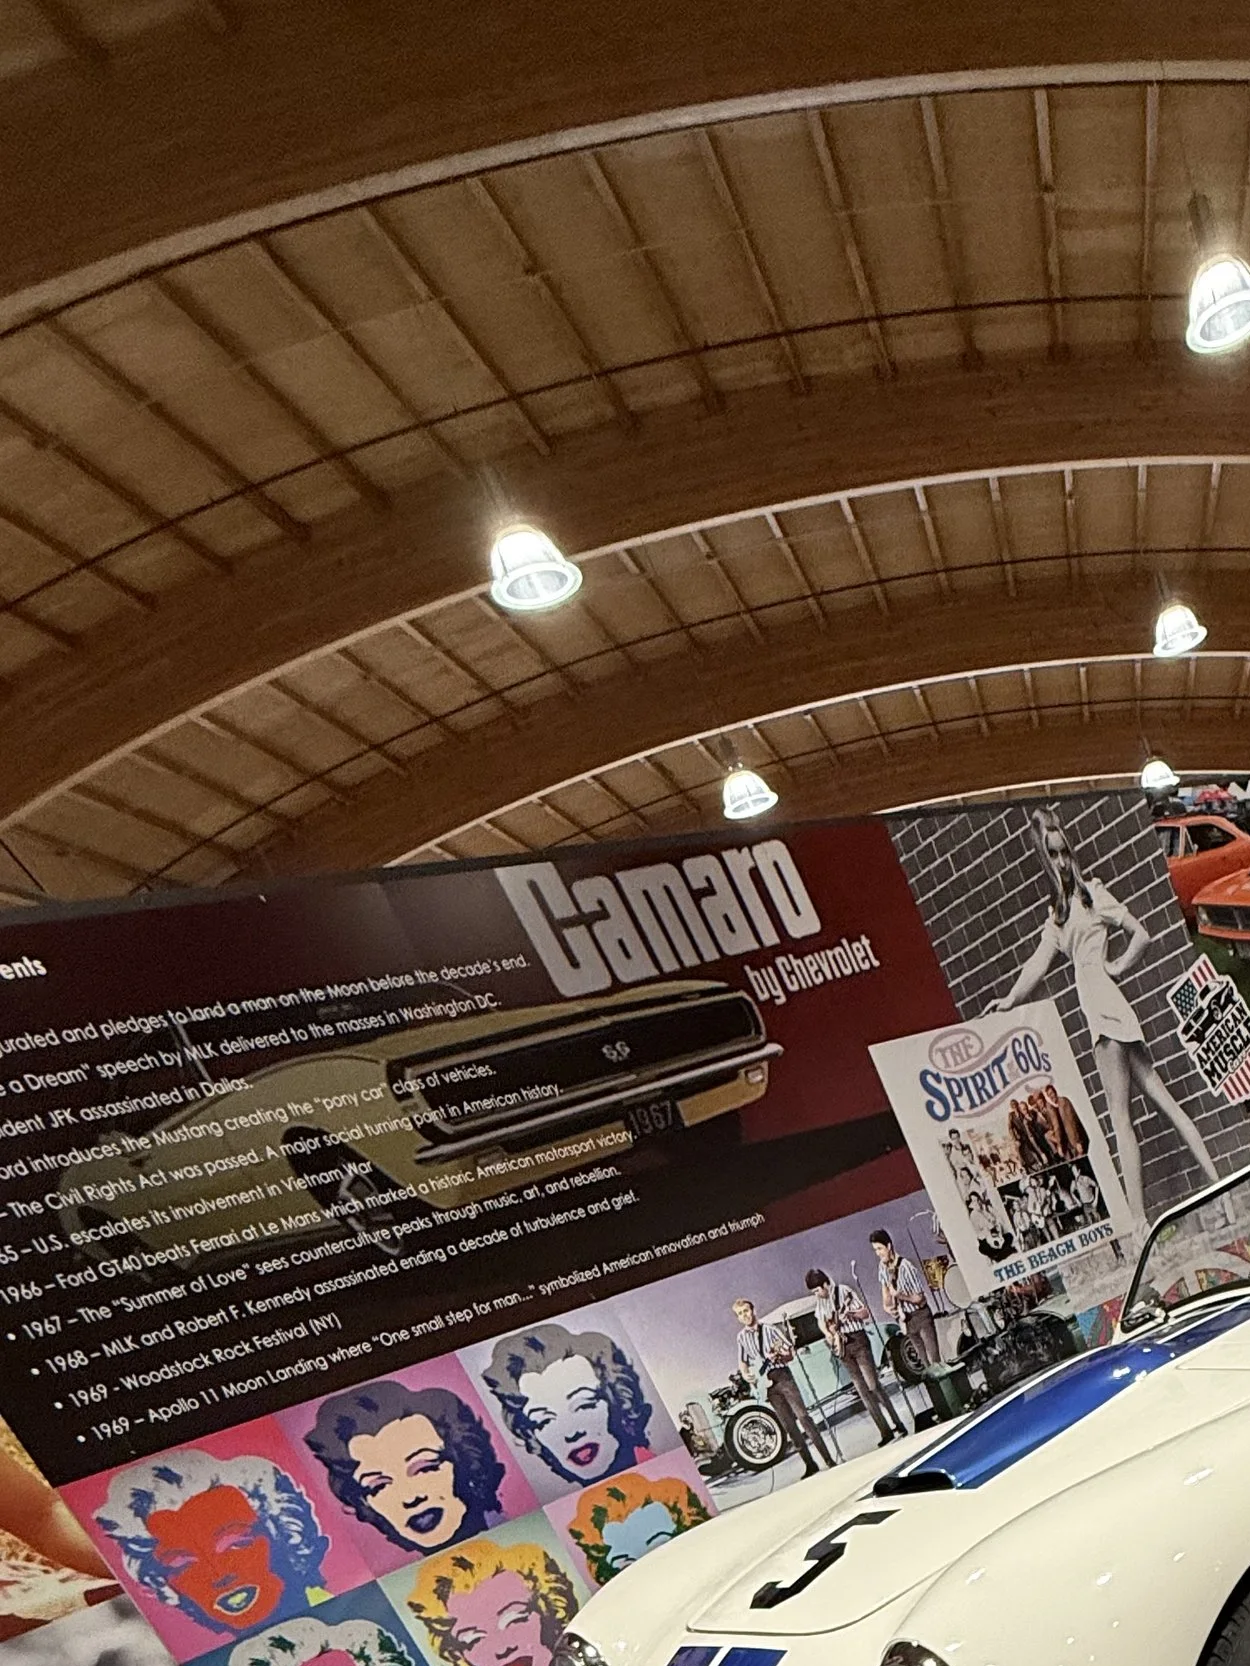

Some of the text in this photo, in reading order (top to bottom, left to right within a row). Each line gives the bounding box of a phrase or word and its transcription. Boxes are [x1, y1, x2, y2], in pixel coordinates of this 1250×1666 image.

[494, 839, 821, 997] Camaro
[744, 934, 880, 1006] by Chevrolet
[919, 1034, 1052, 1122] SPIRIT 60s
[1196, 1002, 1247, 1069] AMERICAN
[628, 1100, 674, 1138] 1967
[21, 1314, 62, 1339] 1967
[76, 1305, 112, 1323] The
[110, 1283, 187, 1312] "Summer
[189, 1274, 208, 1293] of
[205, 1262, 250, 1288] Love"
[254, 1256, 289, 1275] sees
[289, 1228, 391, 1265] counterculture
[391, 1215, 433, 1240] peaks
[430, 1200, 484, 1225] through
[544, 1176, 570, 1194] and
[44, 1349, 89, 1373] 1968
[101, 1334, 140, 1357] MLK
[139, 1323, 175, 1346] and
[172, 1307, 230, 1336] Robert
[227, 1304, 246, 1320] F.
[243, 1285, 311, 1315] Kennedy
[312, 1258, 399, 1295] assassinated
[399, 1247, 447, 1270] ending
[446, 1244, 458, 1256] a
[458, 1228, 509, 1252] decade
[508, 1221, 523, 1237] of
[522, 1206, 586, 1233] turbulence
[586, 1197, 611, 1215] and
[994, 1223, 1113, 1283] THE BEACH BOYS
[67, 1382, 107, 1407] 1969
[118, 1352, 214, 1390] Woodstock
[211, 1339, 255, 1363] Rock
[251, 1321, 309, 1350] Festival
[308, 1311, 342, 1336] (NY)
[90, 1415, 129, 1440] 1969
[147, 1396, 200, 1423] Apollo
[198, 1387, 219, 1404] 11
[220, 1375, 268, 1398] Moon
[265, 1355, 329, 1383] Landing
[326, 1341, 372, 1363] where
[371, 1328, 410, 1346] "One
[410, 1314, 445, 1337] small
[444, 1308, 473, 1326] step
[471, 1301, 492, 1316] for
[537, 1263, 602, 1296] symbolized
[601, 1249, 654, 1275] American
[706, 1222, 729, 1240] and
[750, 1508, 902, 1609] 5
